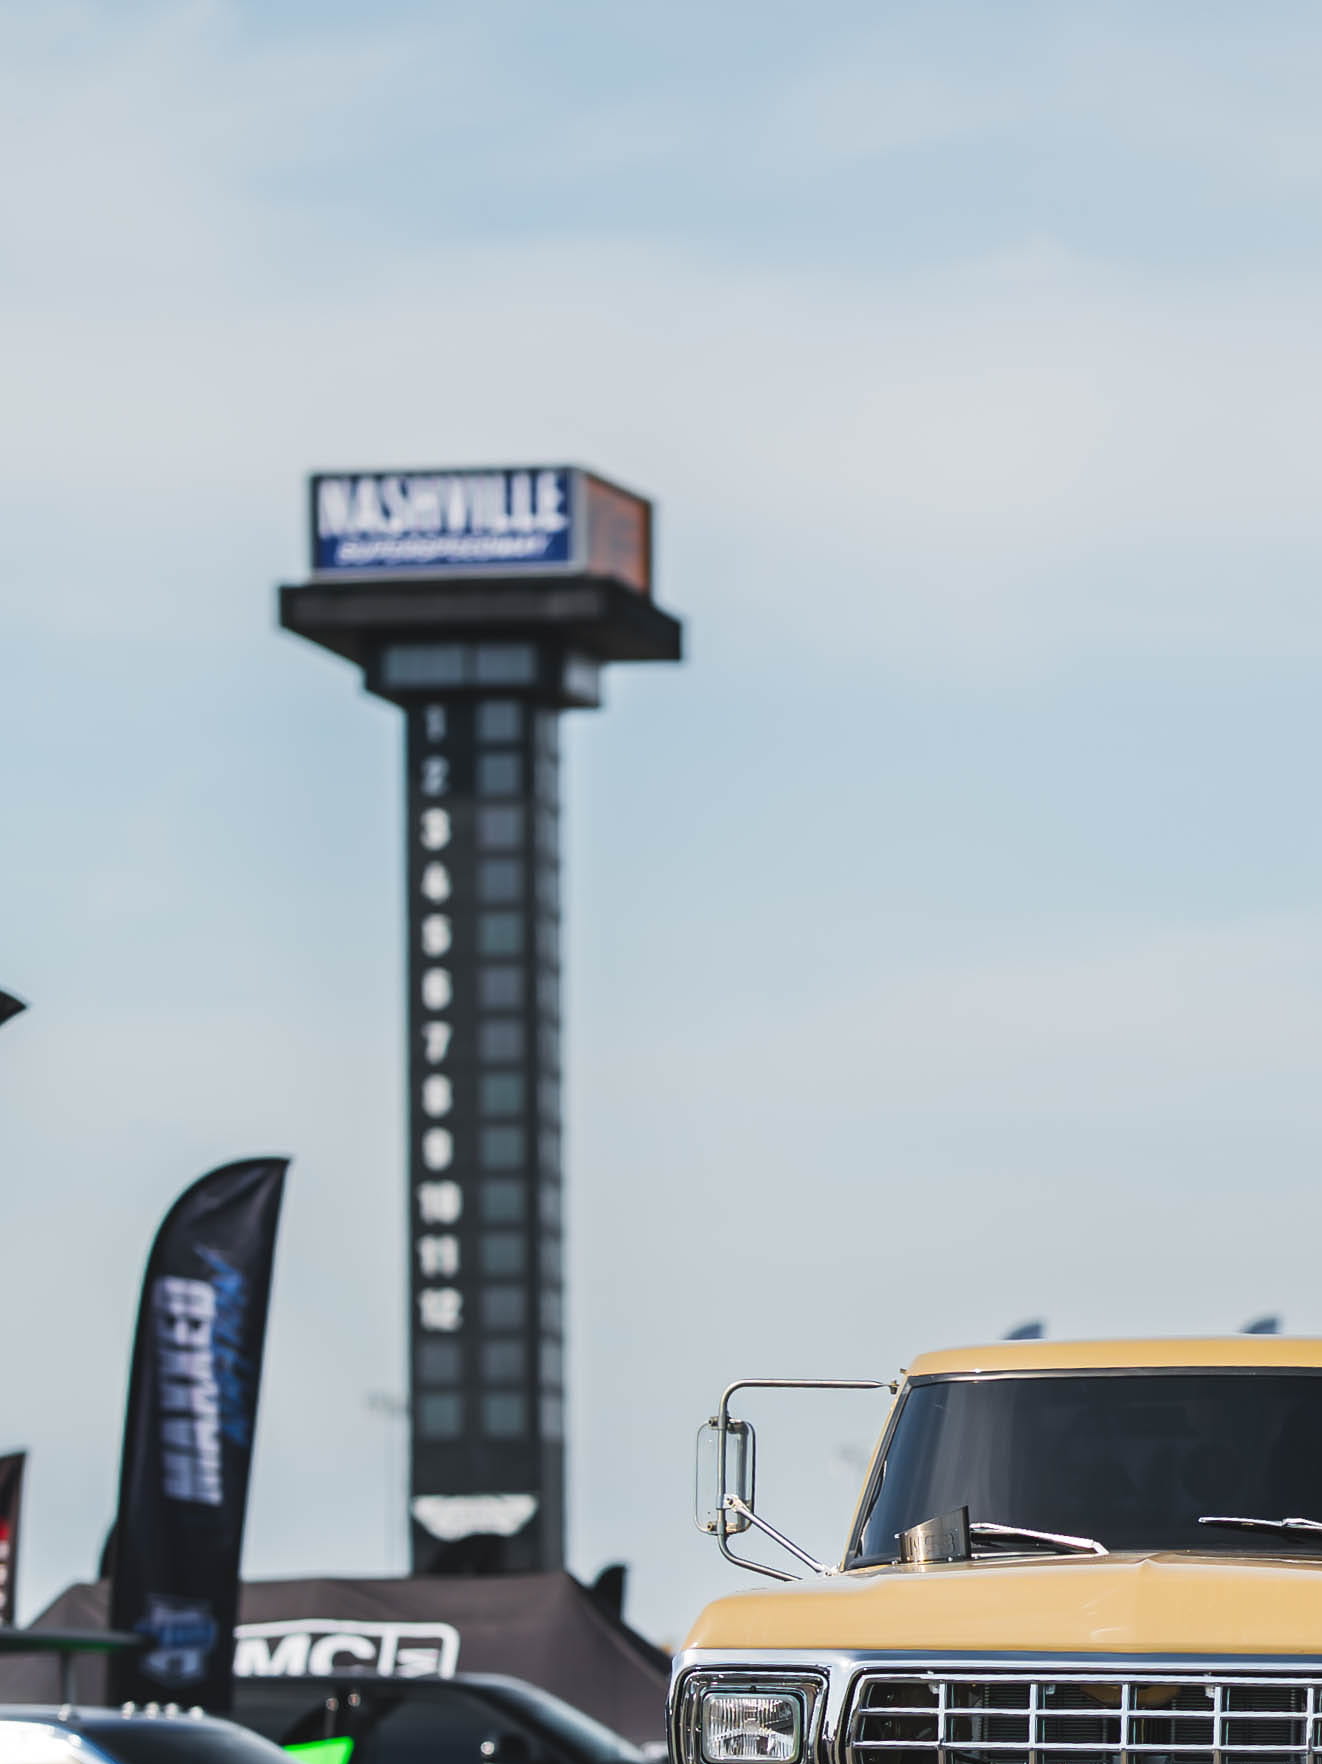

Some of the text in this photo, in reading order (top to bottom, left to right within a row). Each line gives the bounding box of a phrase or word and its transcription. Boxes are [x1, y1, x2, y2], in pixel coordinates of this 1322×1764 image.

[317, 470, 569, 538] NASHVILLE
[424, 1022, 451, 1062] 7
[233, 1633, 376, 1677] MC
